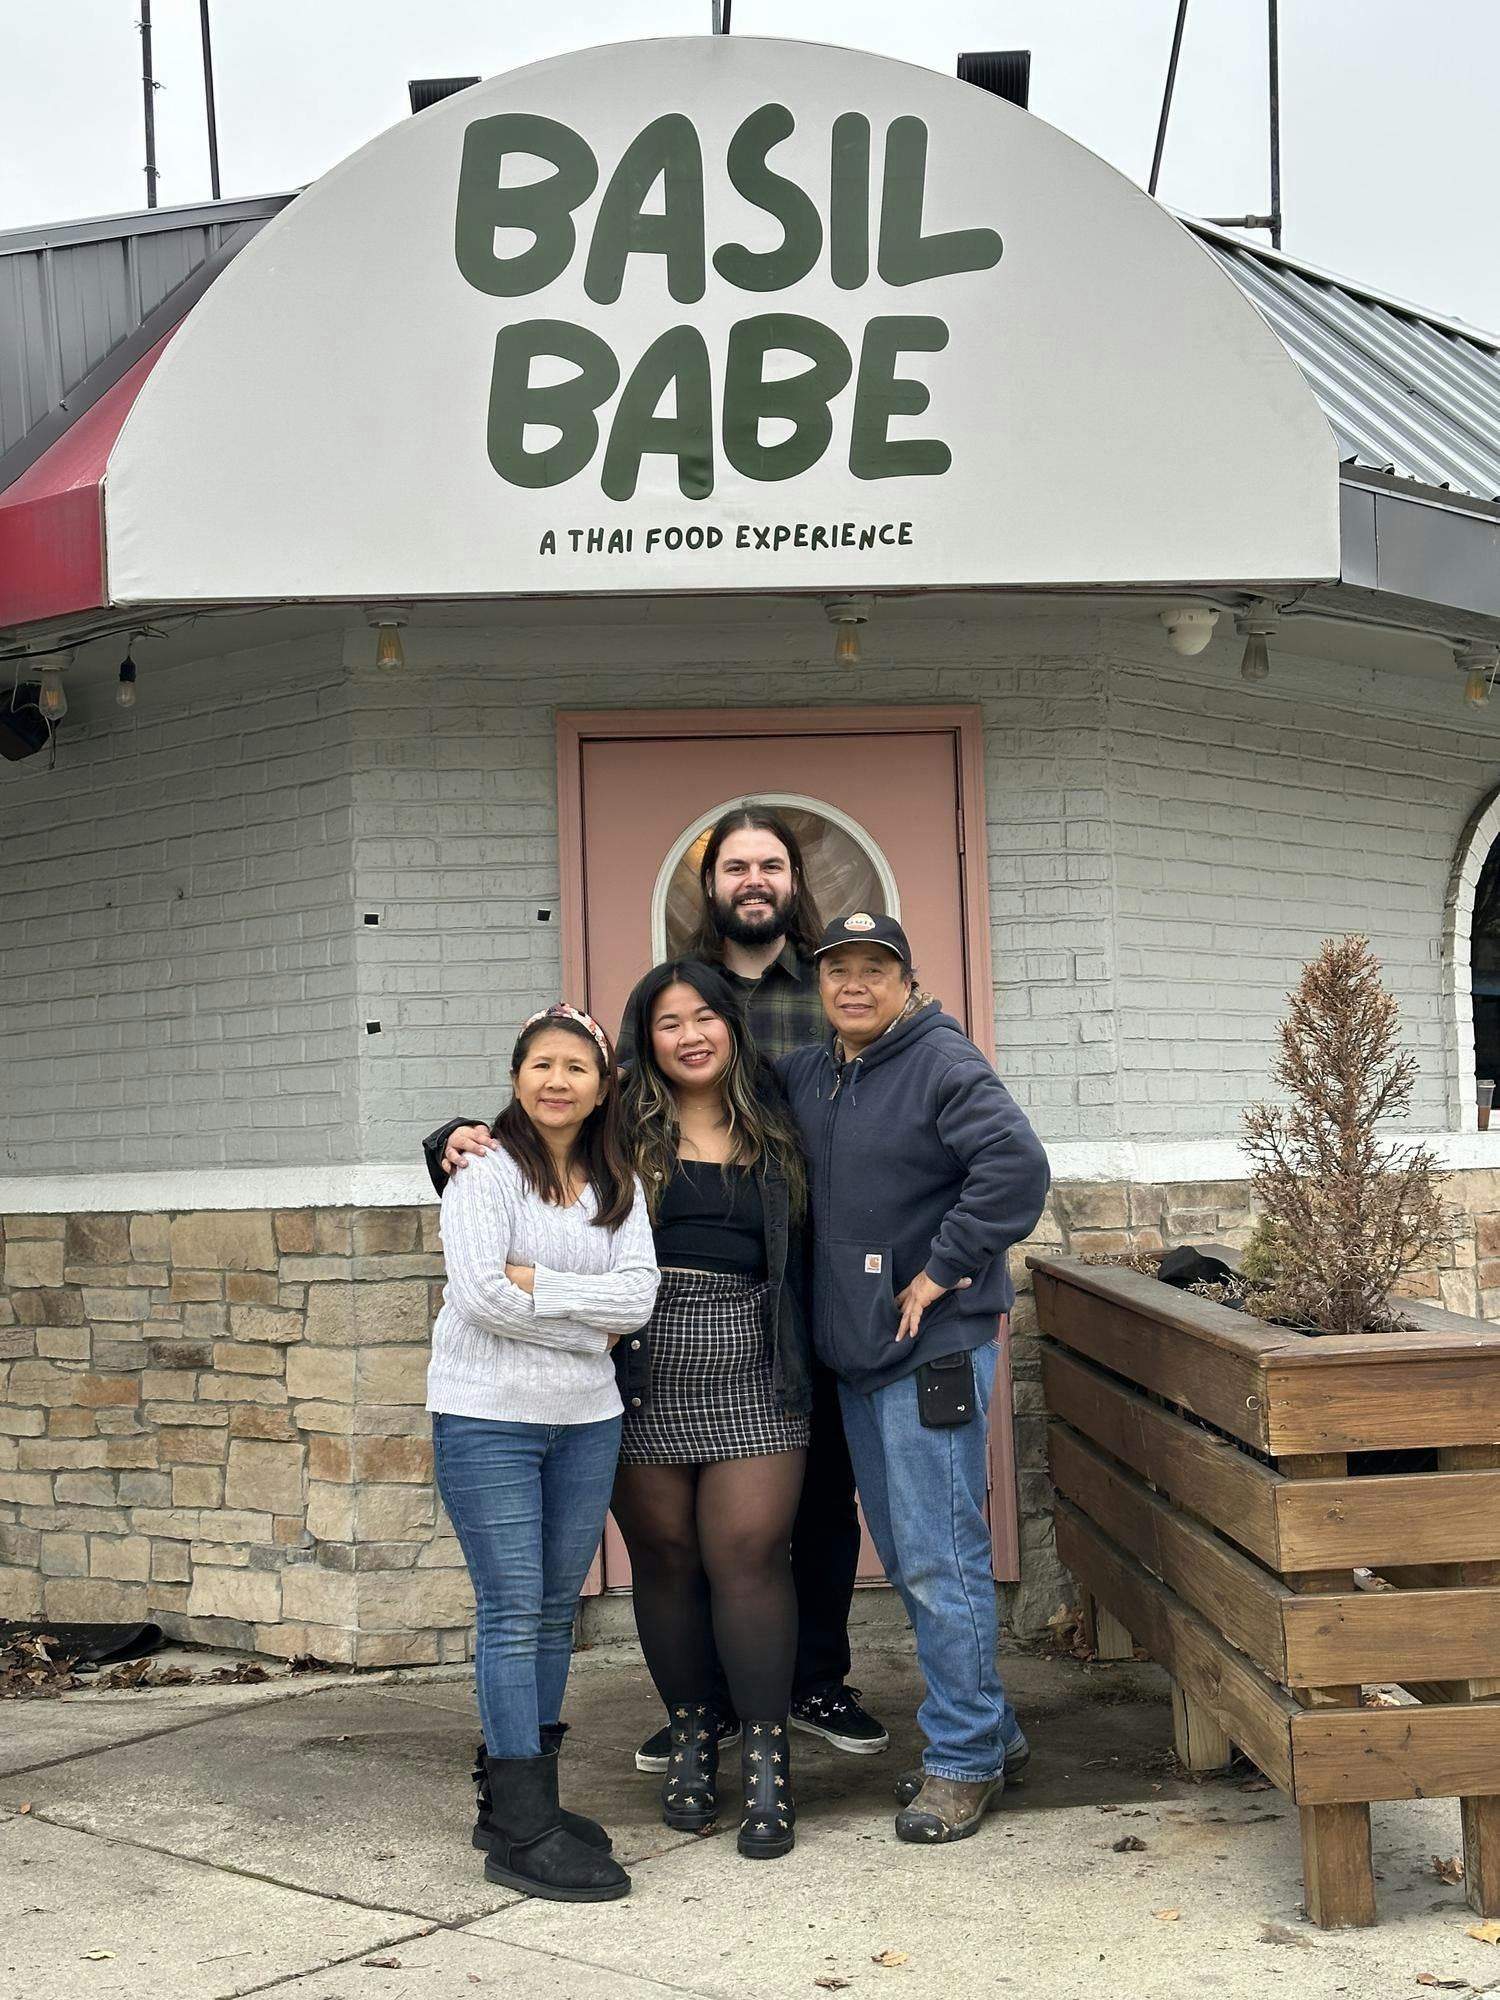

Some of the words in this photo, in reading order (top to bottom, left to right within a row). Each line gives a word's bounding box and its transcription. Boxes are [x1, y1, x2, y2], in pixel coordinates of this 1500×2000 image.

[455, 103, 1003, 305] BASIL
[487, 313, 952, 501] BABE
[539, 529, 556, 556] A
[567, 527, 633, 555] THAI
[645, 525, 724, 554] FOOD
[735, 521, 913, 552] EXPERIENCE
